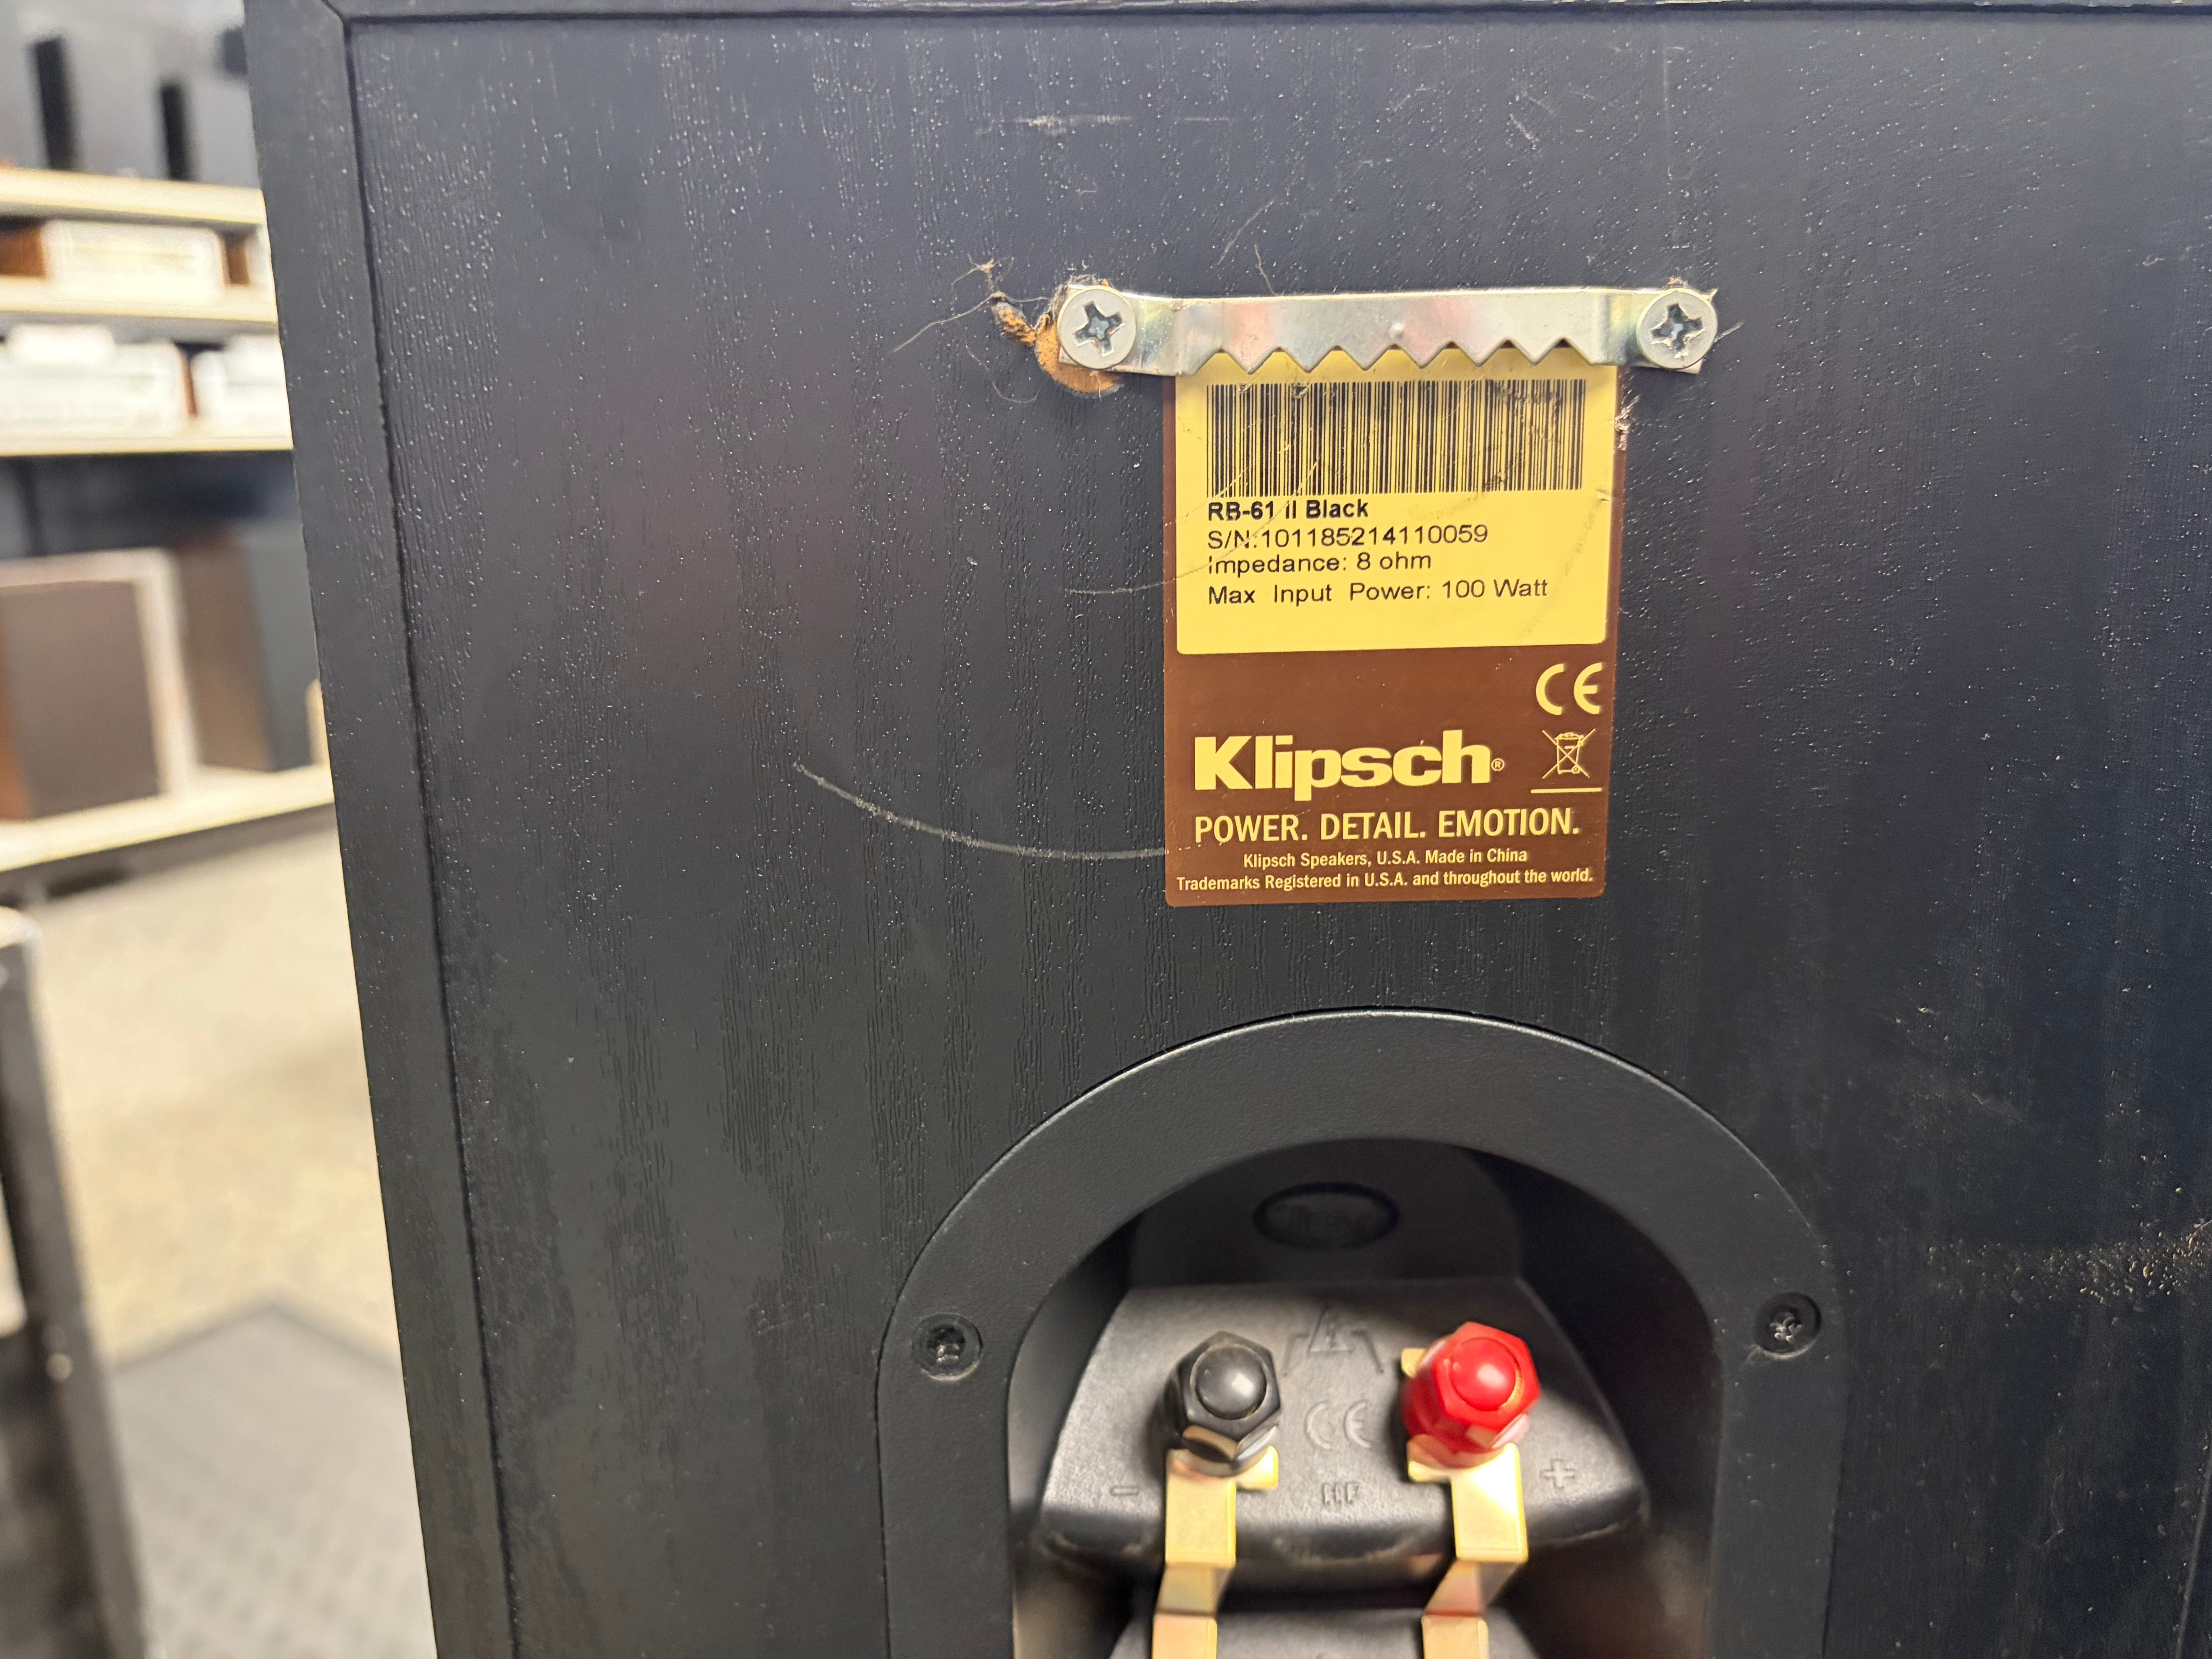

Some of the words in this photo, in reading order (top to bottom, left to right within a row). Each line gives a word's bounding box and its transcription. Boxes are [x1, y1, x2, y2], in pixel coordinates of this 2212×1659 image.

[1208, 500, 1274, 521] RB-61
[1306, 498, 1368, 519] Black
[1208, 524, 1488, 550] S/N:101185214110059
[1209, 554, 1346, 578] Impedance:
[1357, 552, 1371, 570] 8
[1379, 551, 1431, 570] ohm
[1209, 586, 1255, 605] Max
[1274, 584, 1332, 607] Input
[1350, 582, 1431, 601] Power:
[1443, 579, 1485, 598] 100
[1493, 579, 1548, 597] Watt
[1535, 662, 1602, 716] CE
[1195, 814, 1307, 846] POWER.
[1321, 811, 1425, 840] DETAIL.
[1438, 807, 1579, 837] EMOTION.
[1244, 853, 1295, 871] Klipsch
[1300, 852, 1371, 869] Speakers,
[1377, 850, 1420, 865] U.S.A.
[1425, 849, 1465, 864] Made
[1470, 848, 1482, 863] in
[1487, 848, 1527, 862] China
[1176, 875, 1260, 891] Trademarks
[1265, 873, 1341, 891] Registered
[1346, 873, 1359, 887] in
[1365, 872, 1408, 887] U.S.A.
[1412, 871, 1439, 886] and
[1443, 870, 1520, 888] throughout
[1524, 869, 1547, 883] the
[1551, 867, 1593, 882] world.
